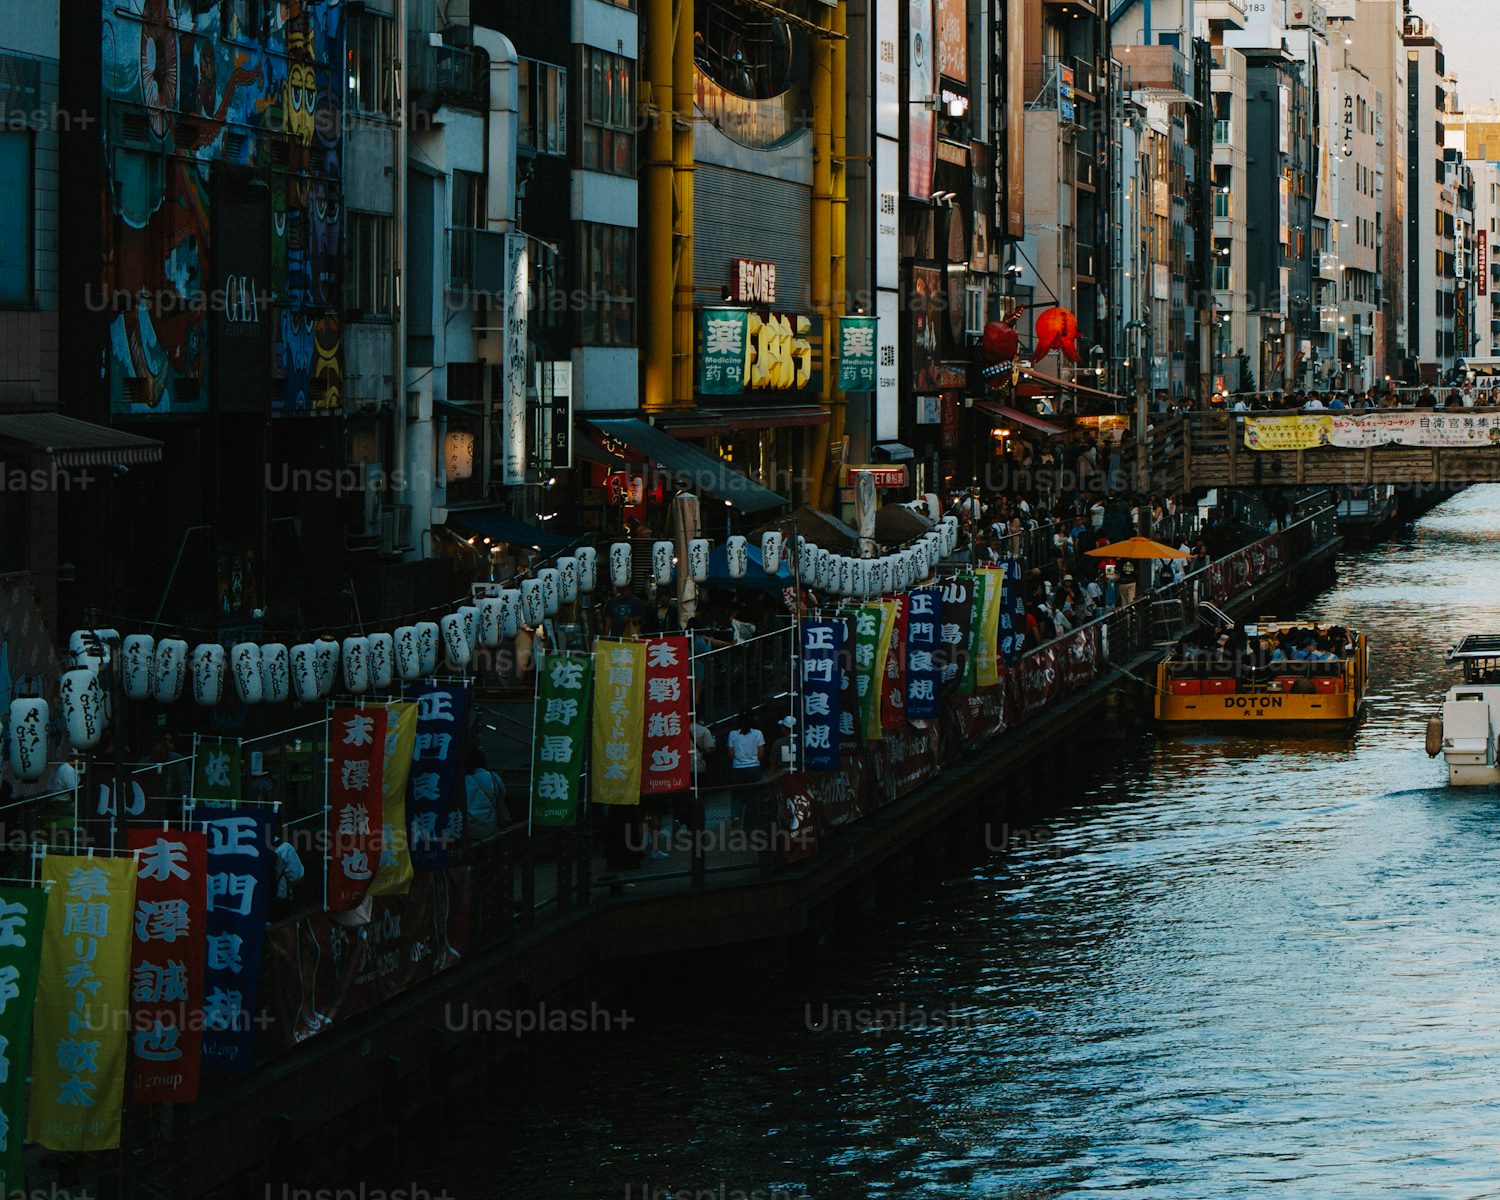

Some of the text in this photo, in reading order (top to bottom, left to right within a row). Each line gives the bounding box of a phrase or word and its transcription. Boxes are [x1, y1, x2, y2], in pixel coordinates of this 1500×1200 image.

[738, 260, 777, 304] 驚安の殿堂
[706, 319, 743, 355] 薬
[843, 327, 875, 358] 薬
[705, 356, 742, 366] Medicine
[706, 366, 742, 382] 药 약
[842, 359, 875, 368] Medicine
[843, 368, 857, 383] 药
[860, 367, 874, 383] 약
[908, 593, 936, 702] 正門良規
[803, 625, 834, 749] 正門良規
[1224, 697, 1283, 708] DOTON
[537, 661, 584, 801] 佐野晶哉
[338, 713, 373, 881] 末澤誠也
[132, 837, 192, 1062] 末澤誠也
